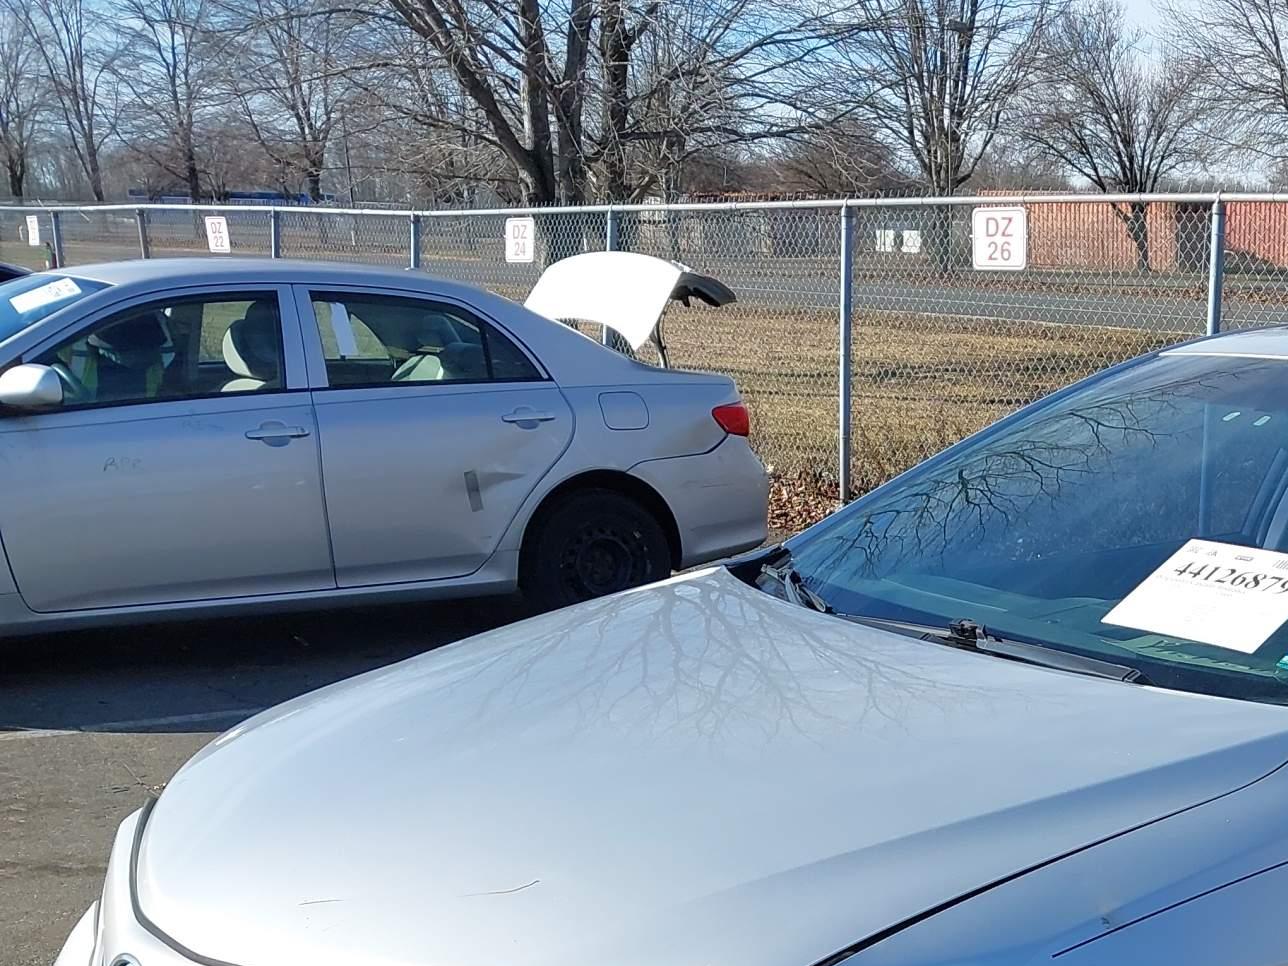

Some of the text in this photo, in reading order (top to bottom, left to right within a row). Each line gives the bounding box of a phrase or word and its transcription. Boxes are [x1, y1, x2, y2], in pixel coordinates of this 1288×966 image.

[211, 222, 223, 234] DZ
[512, 224, 527, 240] DZ
[985, 216, 1014, 237] DZ
[213, 235, 225, 248] 22
[514, 241, 526, 257] 24
[987, 241, 1012, 262] 26
